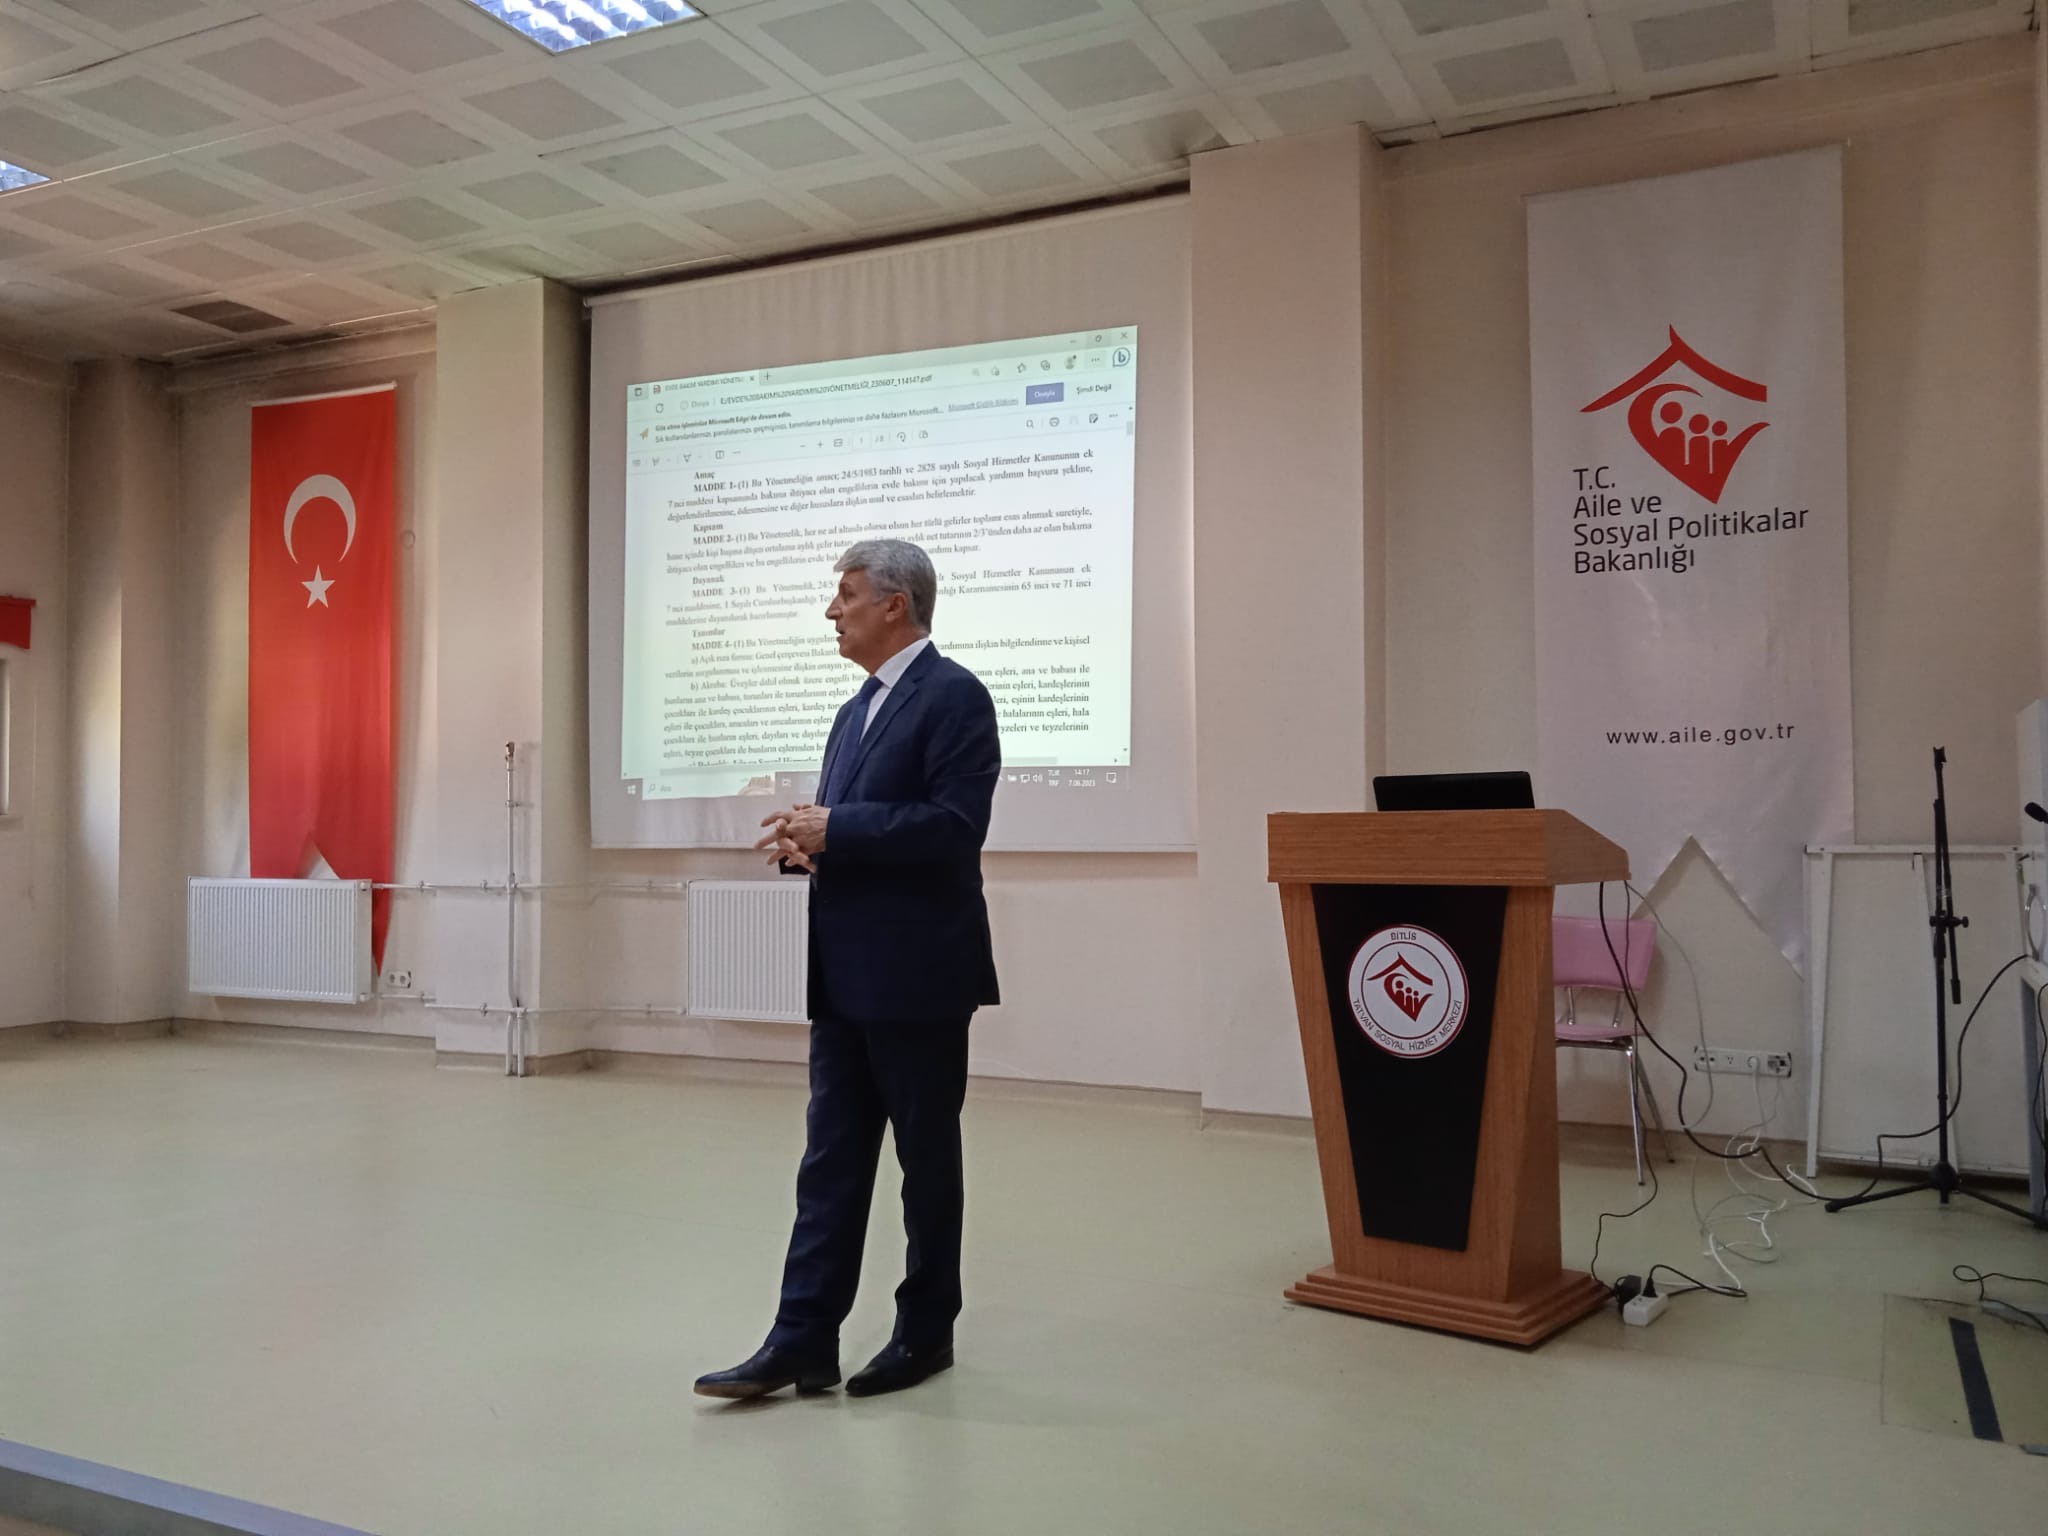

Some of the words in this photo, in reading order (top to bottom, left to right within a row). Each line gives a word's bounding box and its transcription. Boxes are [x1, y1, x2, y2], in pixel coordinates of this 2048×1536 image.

[1076, 385, 1093, 394] Şimdi
[1095, 383, 1111, 392] Değil
[708, 416, 734, 425] Microsoft
[693, 482, 725, 492] MADDE
[765, 474, 812, 487] Yönetmeliğin
[841, 468, 876, 479] 24/5/1983
[879, 466, 901, 475] tarihli
[917, 463, 935, 472] 2828
[939, 460, 959, 472] sayılı
[963, 458, 988, 470] Sosyal
[992, 454, 1030, 465] Hizmetler
[1034, 450, 1079, 462] Kanununun
[1083, 448, 1093, 457] ek
[694, 470, 714, 480] Amaç
[819, 486, 834, 494] olan
[882, 480, 900, 489] evde
[931, 476, 946, 487] için
[950, 472, 985, 485] yapılacak
[989, 469, 1023, 482] yardımın
[1028, 466, 1058, 479] başvuru
[1062, 463, 1092, 476] şekline,
[1573, 466, 1616, 491] T.C.
[790, 501, 808, 512] diğer
[926, 487, 975, 499] belirlemektir.
[1573, 496, 1622, 518] Aile
[1631, 496, 1662, 514] ve
[693, 535, 723, 544] MADDE
[760, 529, 802, 541] Yönetmelik,
[804, 528, 815, 536] her
[828, 526, 836, 534] ad
[888, 520, 908, 529] olsun
[911, 519, 922, 528] her
[924, 518, 941, 527] türlü
[944, 515, 970, 527] gelirler
[1022, 509, 1052, 519] alınmak
[1055, 506, 1092, 519] suretiyle,
[693, 521, 723, 533] Kapsam
[926, 532, 937, 540] net
[939, 529, 971, 540] tutarının
[1013, 525, 1031, 534] daha
[1043, 523, 1061, 532] olan
[1062, 520, 1091, 530] bakıma
[1573, 517, 1658, 548] Sosyal
[1669, 506, 1809, 540] Politikalar
[808, 553, 824, 562] evde
[954, 542, 980, 554] kapsar.
[1574, 544, 1695, 574] Bakanlığı
[692, 587, 722, 597] MADDE
[951, 571, 976, 582] Sosyal
[983, 568, 1021, 578] Hizmetler
[1028, 564, 1074, 575] Kanununun
[1081, 563, 1091, 572] ek
[693, 574, 724, 585] Dayanak
[958, 582, 1019, 594] Kararnamesinin
[1021, 582, 1031, 590] 65
[1063, 579, 1072, 587] 71
[1075, 578, 1090, 587] inci
[692, 640, 723, 649] MADDE
[755, 650, 775, 659] Genel
[975, 639, 998, 650] ilişkin
[1000, 637, 1051, 649] bilgilendirme
[1064, 635, 1090, 646] kişisel
[994, 666, 1018, 677] eşleri,
[1050, 663, 1076, 672] babası
[1079, 663, 1089, 671] ile
[1012, 680, 1036, 691] eşleri,
[1038, 678, 1089, 690] kardeşlerinin
[1011, 694, 1034, 704] eşinin
[1038, 692, 1089, 704] kardeşlerinin
[1002, 708, 1044, 717] halalarının
[1046, 707, 1070, 718] eşleri,
[1072, 707, 1089, 715] hala
[1042, 721, 1088, 733] teyzelerinin
[1606, 723, 1795, 746] www.aile.gov.tr
[1352, 998, 1374, 1031] TATVAN
[1374, 1029, 1405, 1051] SOSYAL
[1408, 1035, 1438, 1051] HİZMET
[1439, 1000, 1463, 1038] MERKEZİ
